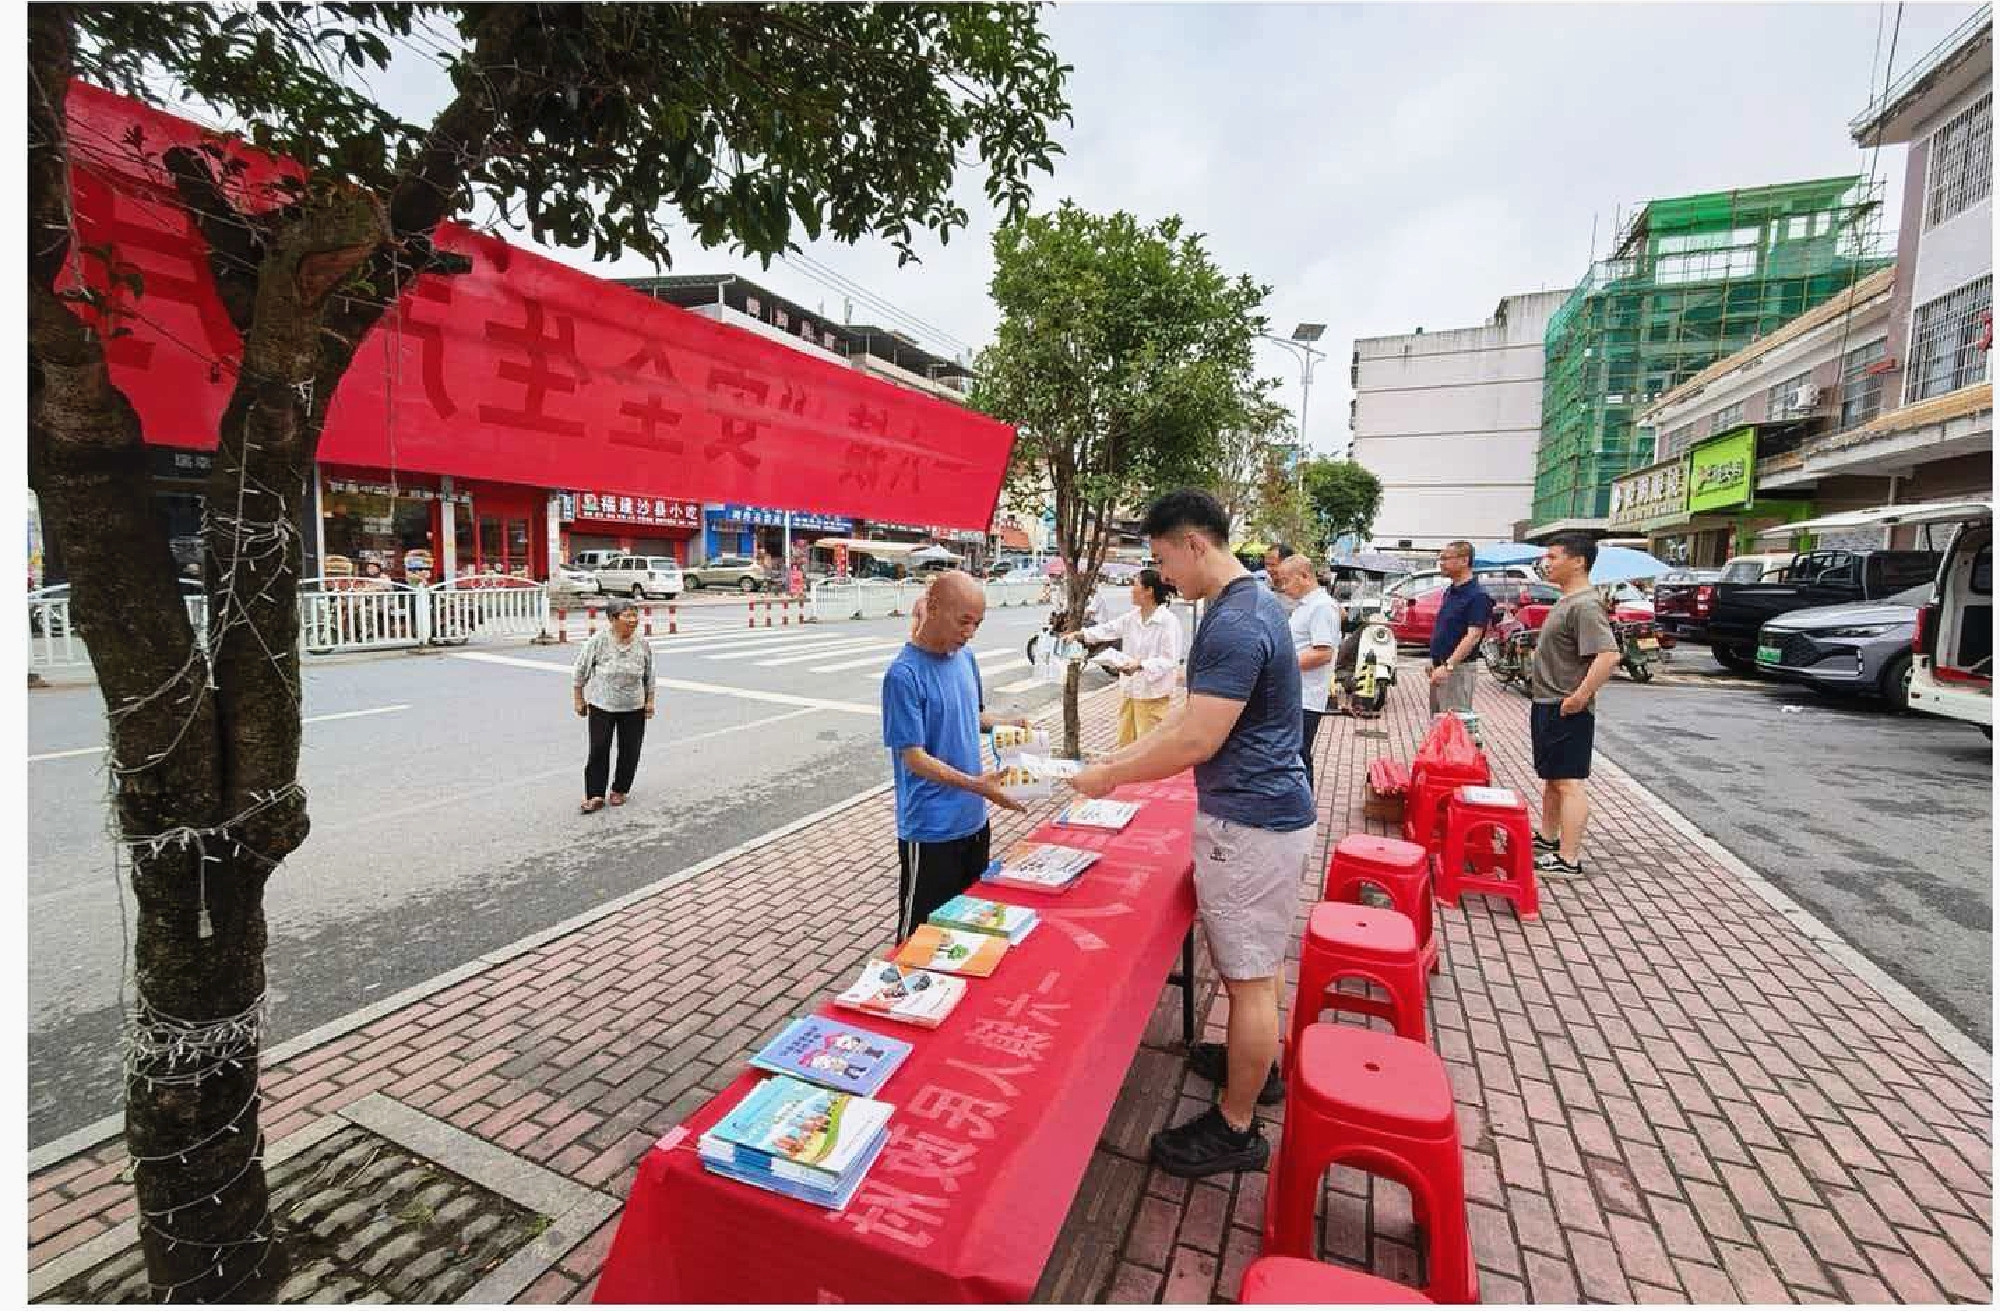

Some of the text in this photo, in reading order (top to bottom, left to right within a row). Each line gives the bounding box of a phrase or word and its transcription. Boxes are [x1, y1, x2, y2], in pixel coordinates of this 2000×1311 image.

[601, 495, 698, 519] 福建沙县小吃
